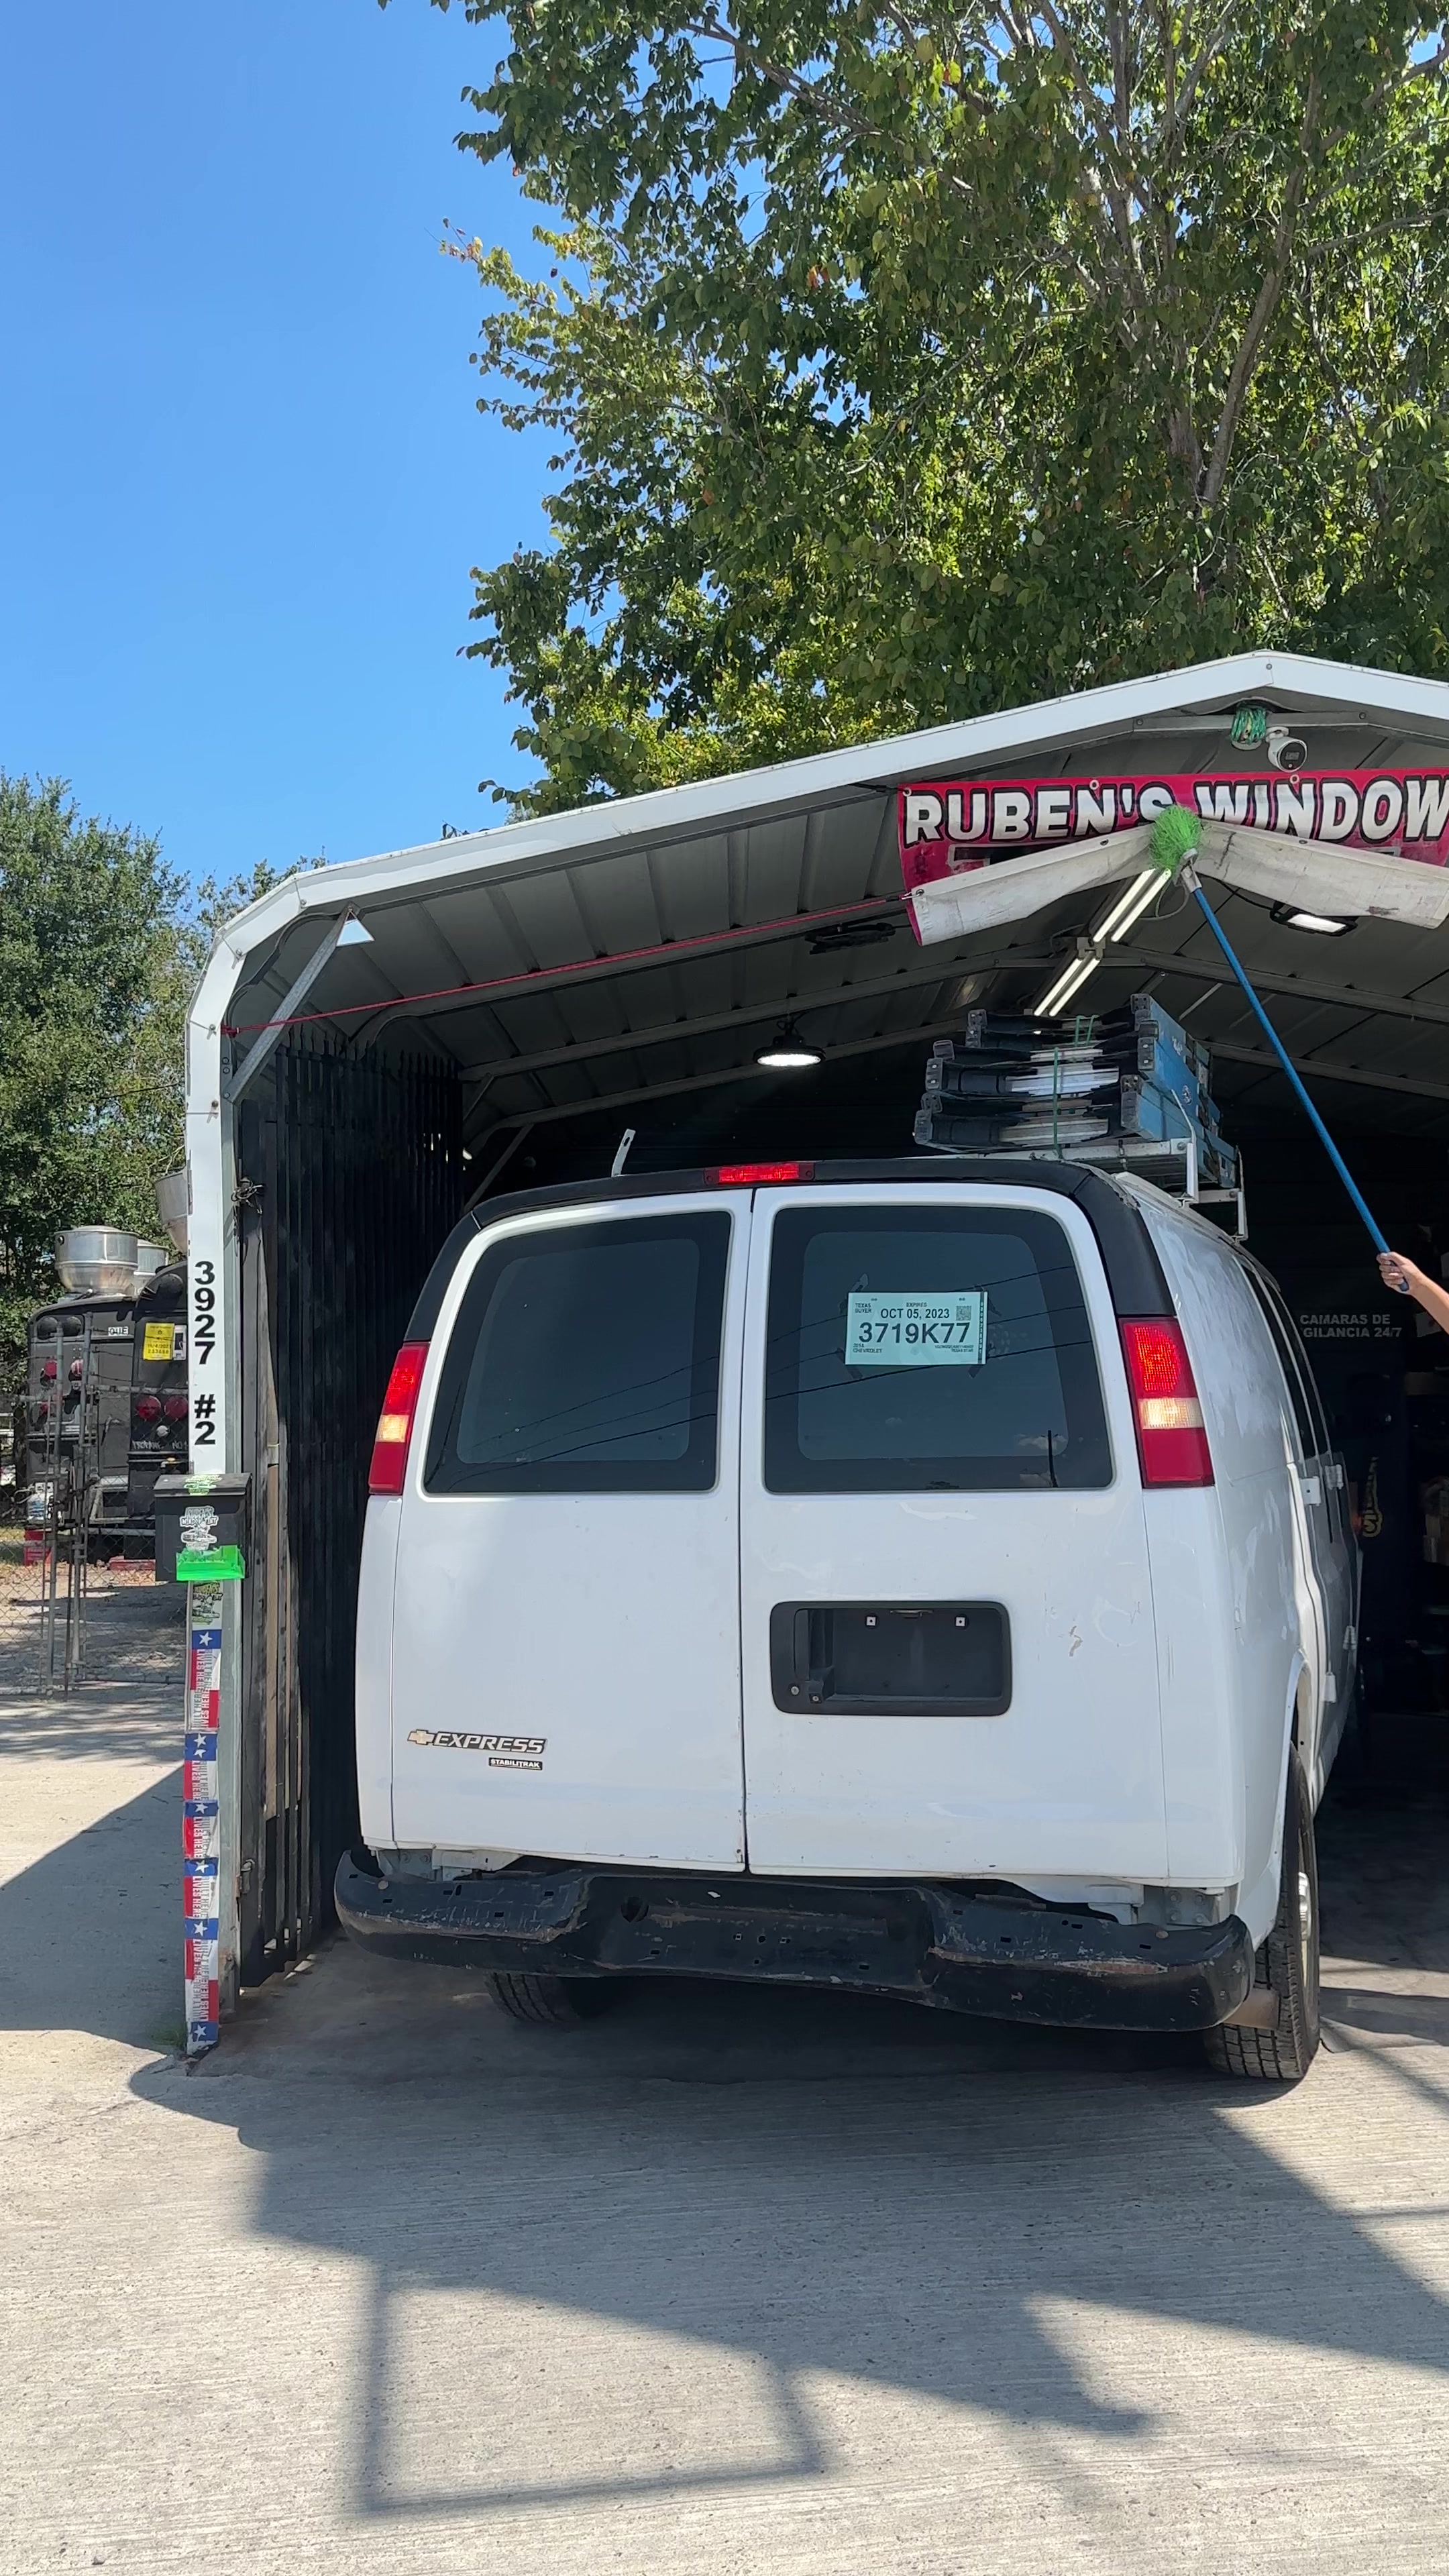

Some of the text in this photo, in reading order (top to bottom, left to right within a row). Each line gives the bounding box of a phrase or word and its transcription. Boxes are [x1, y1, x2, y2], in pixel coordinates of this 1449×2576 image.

[904, 775, 1449, 848] RUBEN'S WINDOW
[194, 1260, 216, 1365] 3927
[880, 1308, 950, 1320] OCT 05, 2023
[1299, 1314, 1391, 1324] CAMARAS DE
[858, 1322, 970, 1344] 3719K77
[1299, 1327, 1370, 1338] GILANCIA
[435, 1732, 545, 1754] EXPRESS
[192, 1760, 201, 1781] LIVES
[490, 1758, 540, 1768] STABILITRAK
[193, 1817, 203, 1858] LIVES HERE
[193, 1876, 202, 1918] LIVES HERE
[193, 1939, 202, 1962] LIVES
[200, 2000, 209, 2022] LIVES
